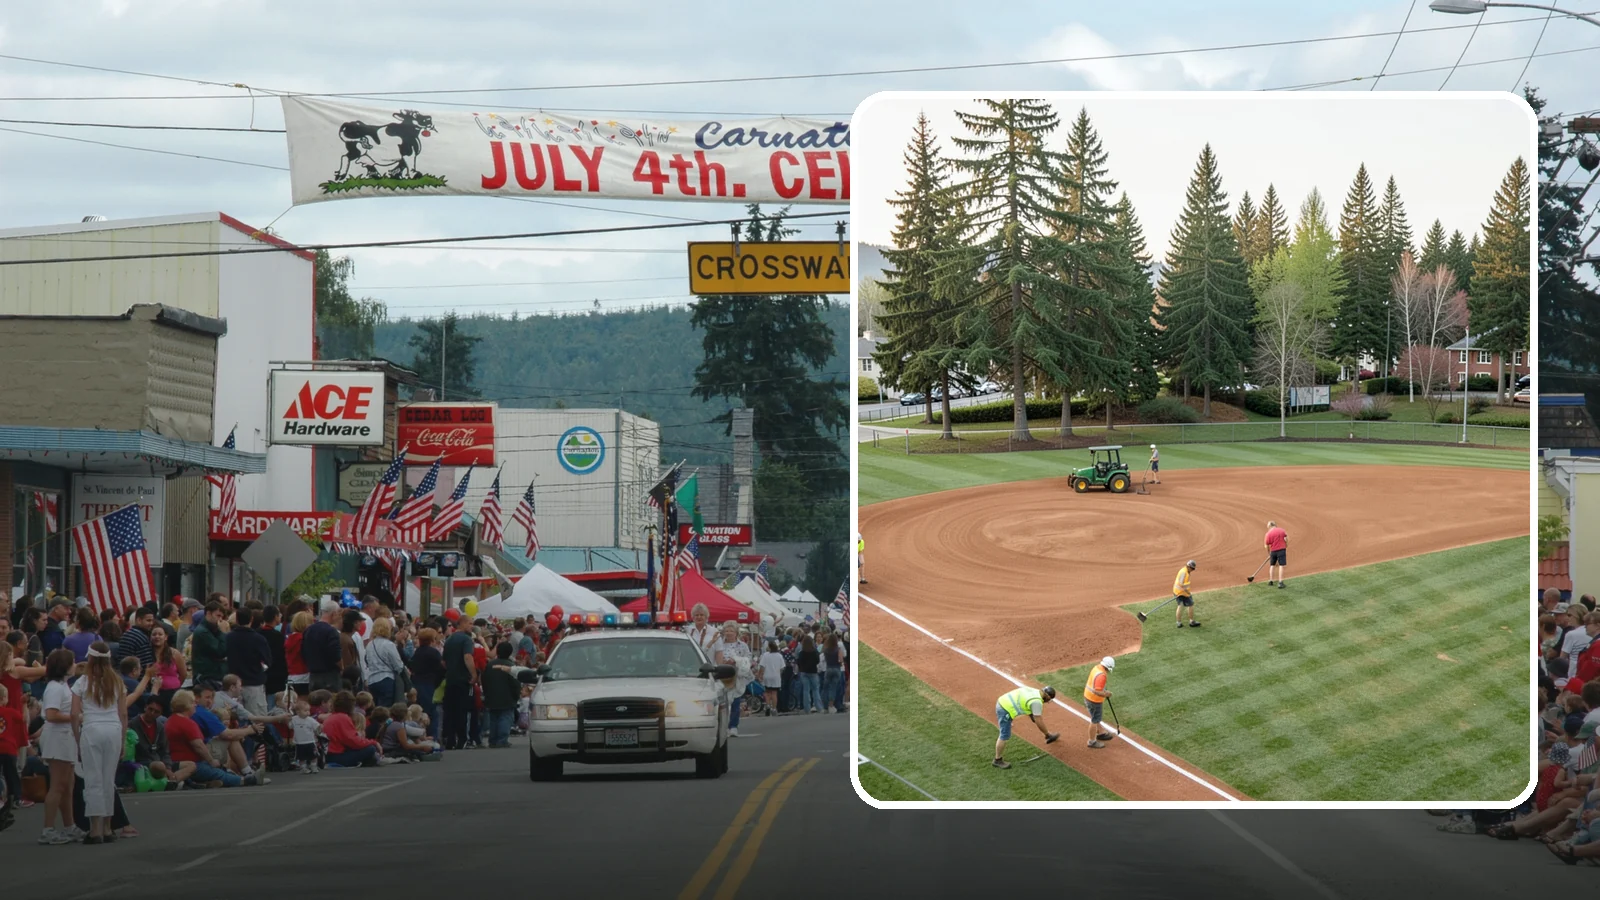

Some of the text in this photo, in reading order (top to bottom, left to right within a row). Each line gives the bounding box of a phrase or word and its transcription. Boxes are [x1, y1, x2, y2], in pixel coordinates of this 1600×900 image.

[694, 121, 850, 149] Carnat
[481, 140, 604, 192] JULY
[632, 150, 746, 198] 4th.
[696, 254, 850, 280] CROSSWA
[283, 380, 373, 420] ACE
[405, 409, 485, 422] CEDAR LOG
[283, 421, 371, 437] Hardware
[83, 485, 155, 495] St. Vincent de Paul
[212, 516, 331, 536] HARDARE
[688, 526, 742, 535] CRNATION
[699, 535, 730, 543] GLASS
